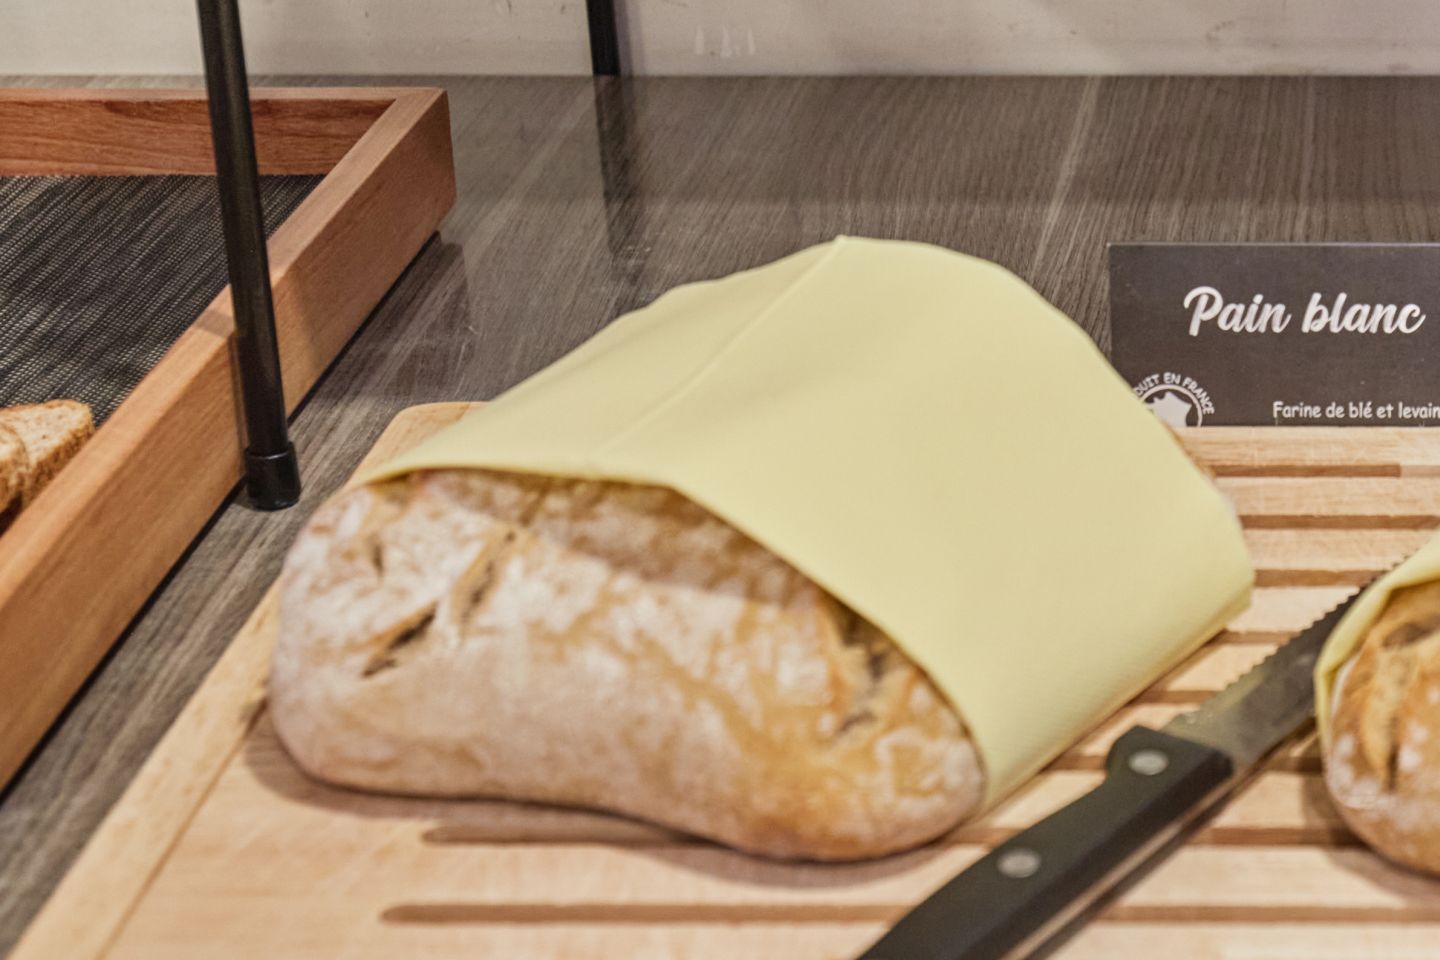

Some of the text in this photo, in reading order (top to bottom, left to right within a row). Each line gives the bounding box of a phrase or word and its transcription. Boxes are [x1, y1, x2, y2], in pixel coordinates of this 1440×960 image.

[1183, 285, 1427, 337] Pain blanc
[1133, 372, 1215, 415] DUIT EN FRANCE
[1272, 400, 1322, 419] Farine
[1325, 401, 1345, 419] de
[1349, 401, 1373, 419] blé
[1376, 403, 1394, 419] et
